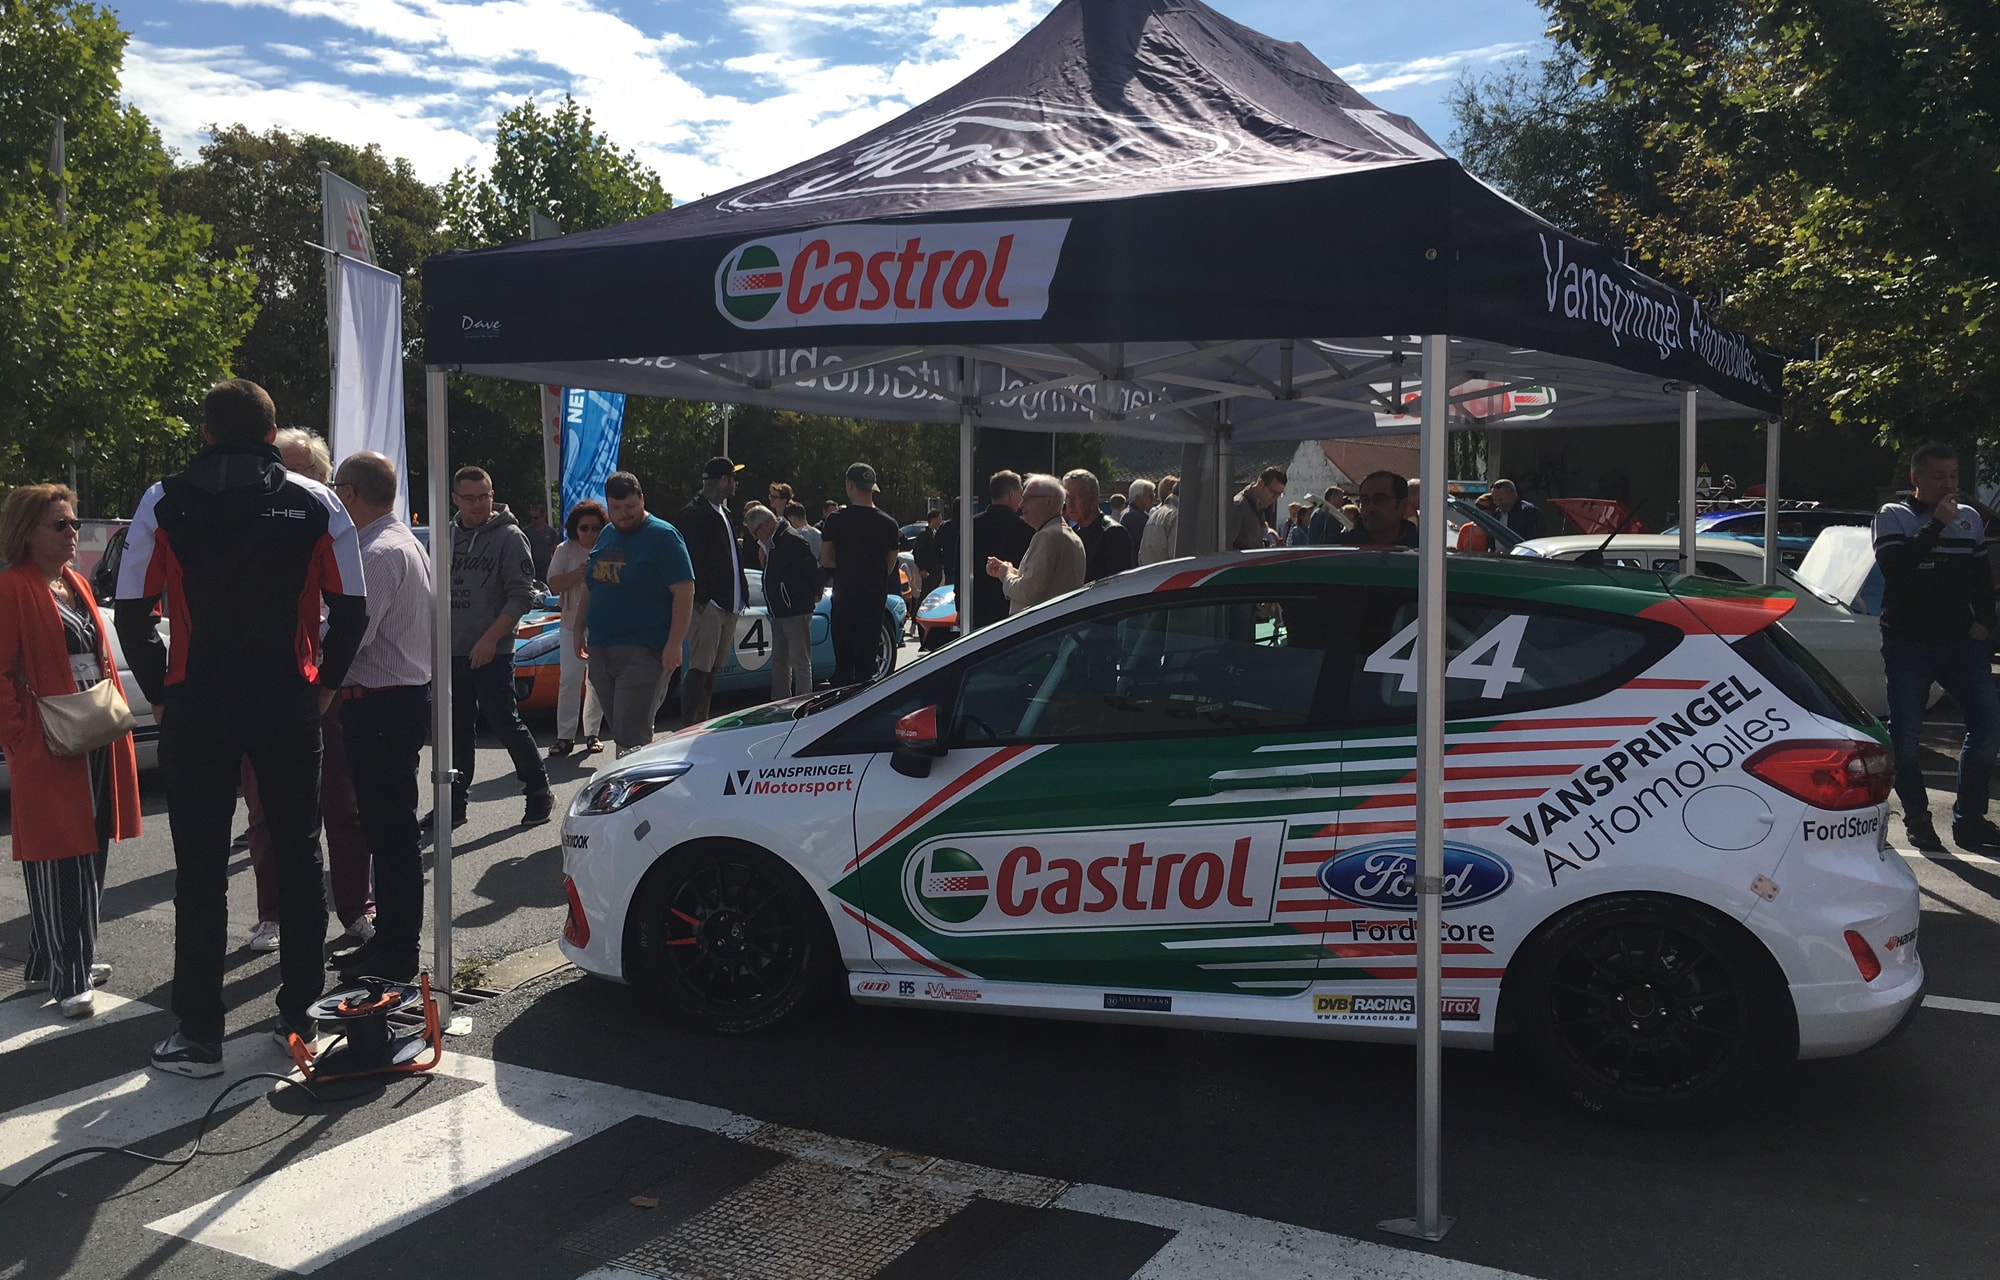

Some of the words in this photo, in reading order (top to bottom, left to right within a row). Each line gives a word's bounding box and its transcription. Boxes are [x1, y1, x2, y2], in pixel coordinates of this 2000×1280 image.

[787, 234, 1015, 315] Castrol
[1539, 233, 1684, 360] Vanspringel
[462, 315, 501, 330] Dave
[739, 618, 769, 657] 4
[1363, 614, 1530, 699] 44
[758, 764, 853, 779] VANSPRINGEL
[1506, 675, 1763, 847] VANSPRINGEL
[754, 778, 853, 797] Motorsport
[1544, 708, 1790, 888] Automobiles
[1803, 817, 1878, 842] FordStore
[996, 836, 1254, 917] Castrol
[1354, 852, 1475, 898] Fod
[899, 981, 916, 994] EPS
[1317, 998, 1349, 1011] DVB
[1354, 998, 1413, 1012] RACING
